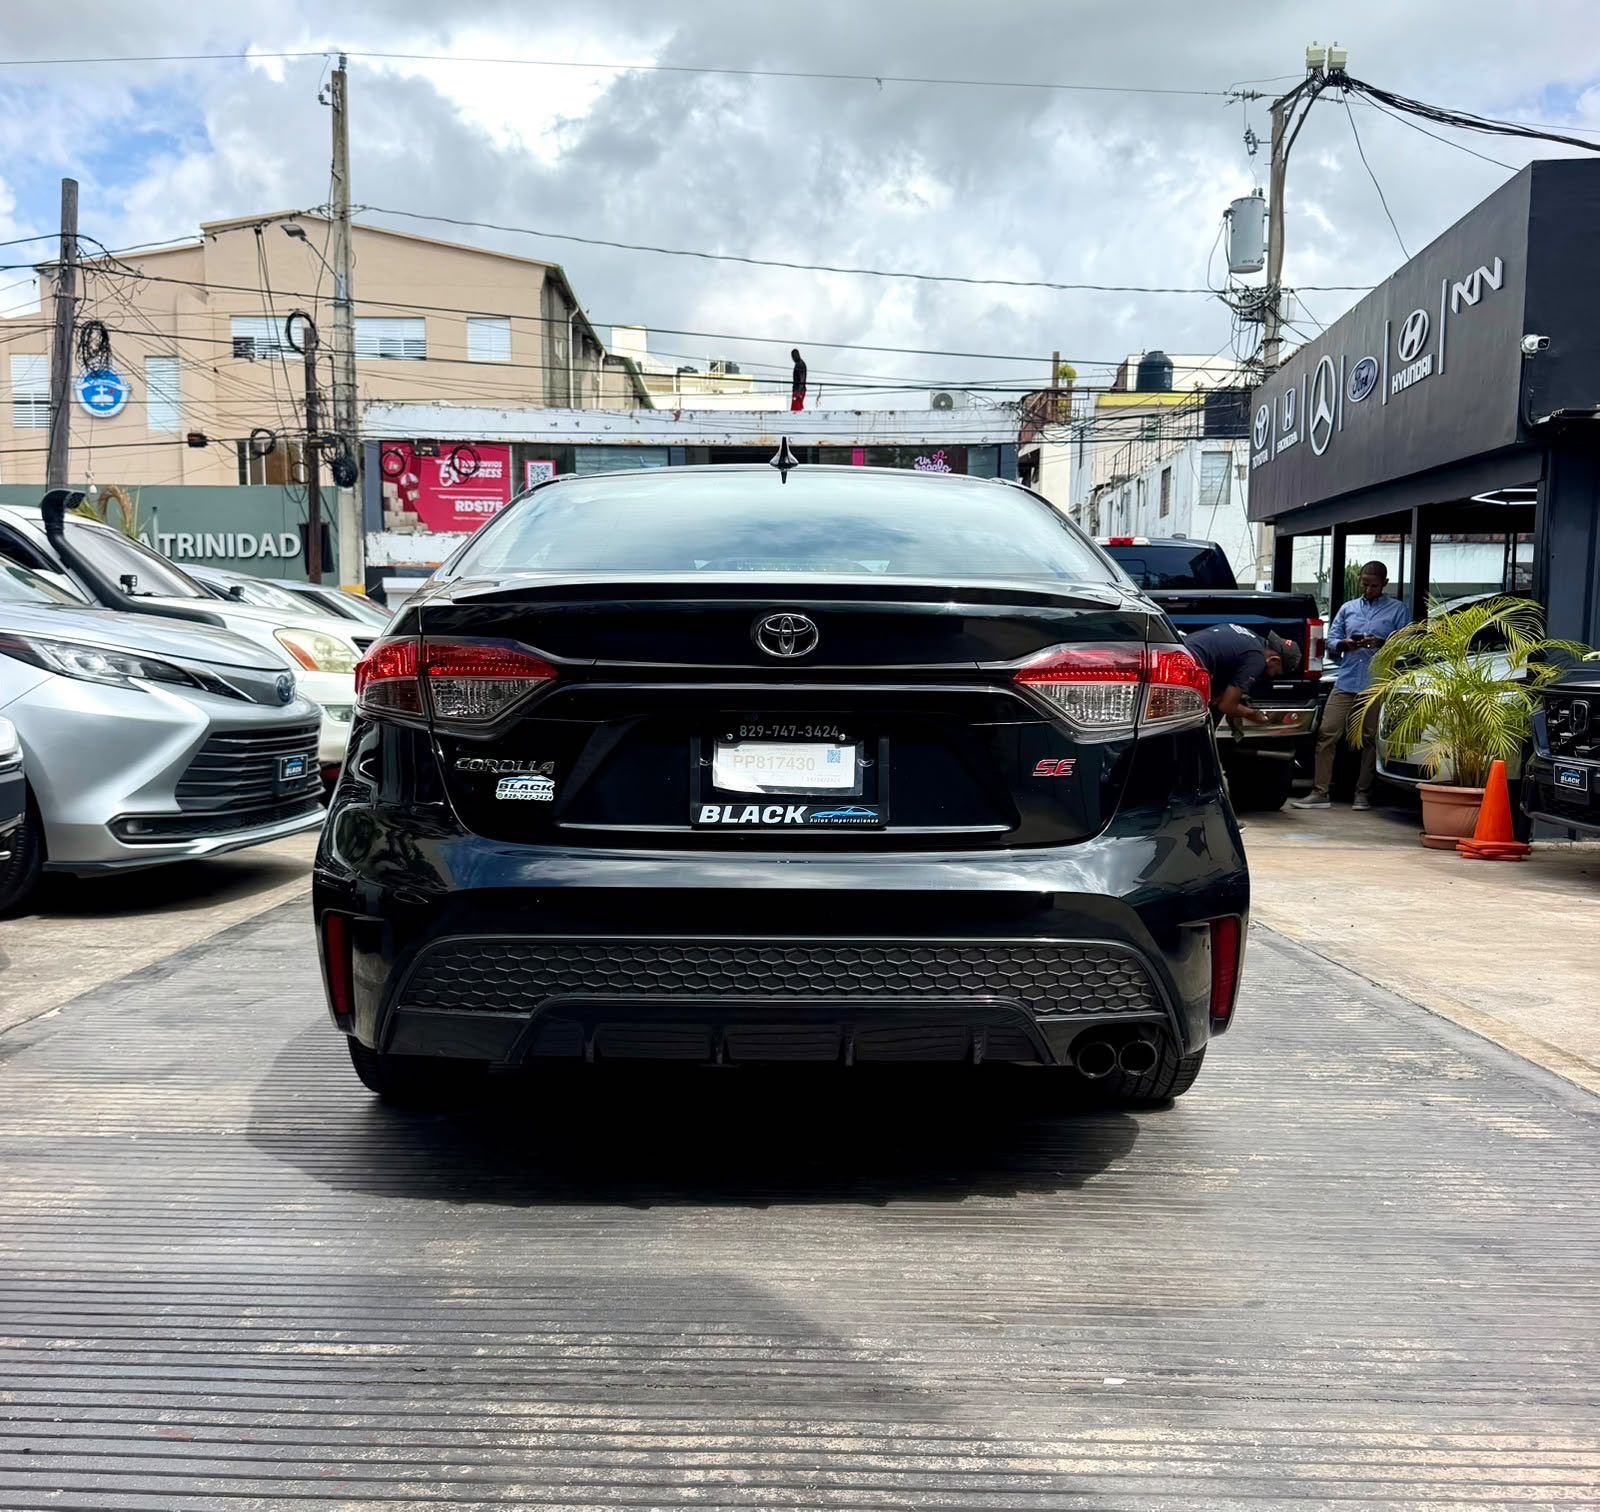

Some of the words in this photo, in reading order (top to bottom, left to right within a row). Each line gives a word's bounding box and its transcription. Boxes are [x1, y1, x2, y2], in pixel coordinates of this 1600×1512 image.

[1391, 354, 1433, 395] HYUNDAI
[158, 533, 301, 558] TRINIDAD
[739, 725, 839, 738] 829-747-3424
[454, 758, 555, 775] COROLLA
[733, 755, 816, 771] PP817430
[1032, 759, 1077, 776] SE
[499, 783, 553, 791] BLACK
[698, 805, 808, 824] BLACK
